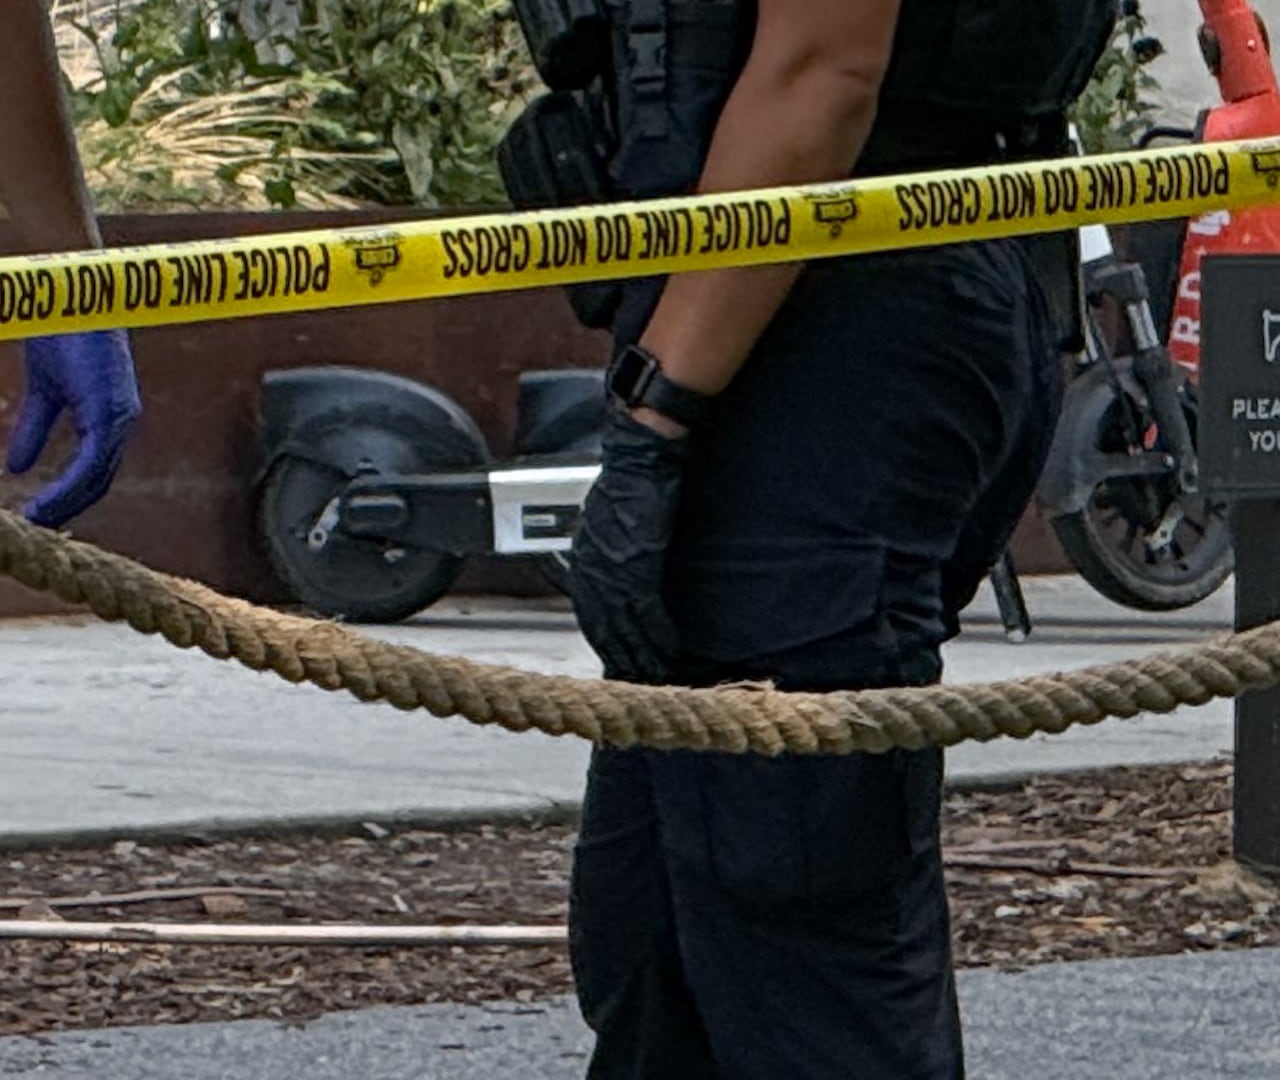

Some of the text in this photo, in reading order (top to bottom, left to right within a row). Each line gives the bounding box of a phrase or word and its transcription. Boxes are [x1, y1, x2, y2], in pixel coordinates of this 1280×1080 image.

[895, 177, 982, 232] CROSS
[986, 170, 1036, 223] NOT
[1041, 166, 1079, 218] DO
[1081, 160, 1138, 212] LINE
[1139, 149, 1230, 205] POLICE
[440, 223, 531, 280] CROSS
[535, 218, 588, 271] NOT
[594, 213, 633, 265] DO
[635, 206, 694, 261] LINE
[696, 196, 791, 255] POLICE
[61, 262, 116, 318] NOT
[124, 258, 163, 312] DO
[166, 251, 228, 308] LINE
[232, 242, 331, 302] POLICE
